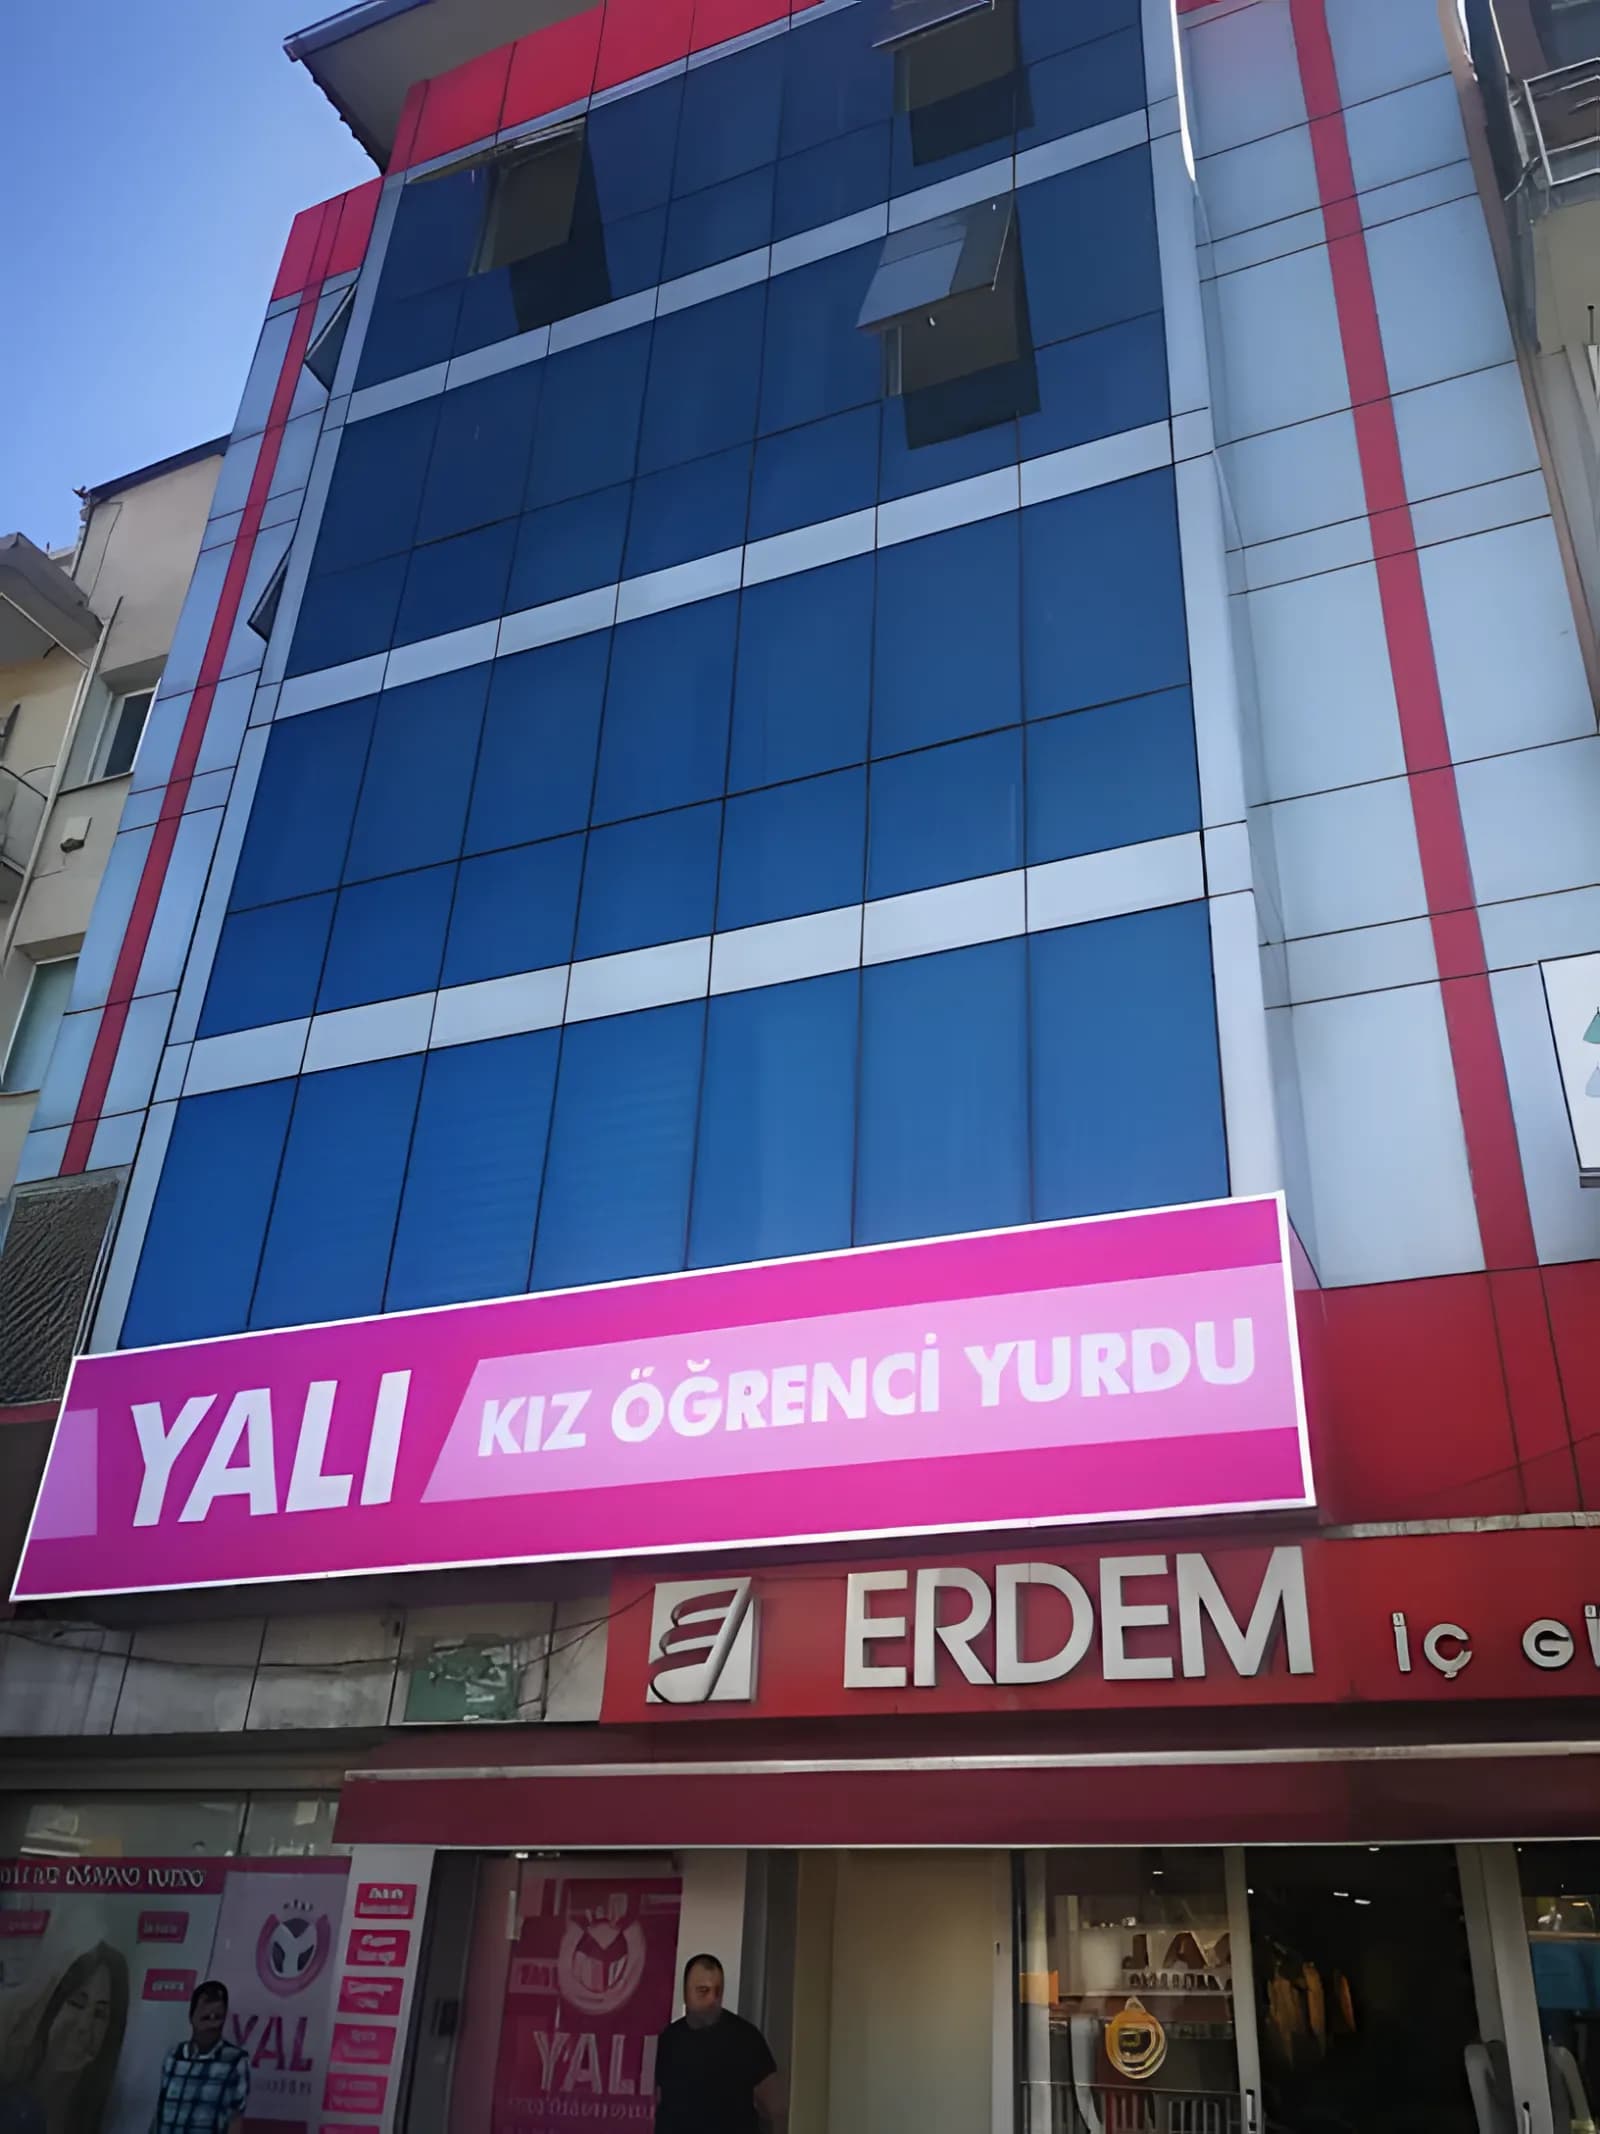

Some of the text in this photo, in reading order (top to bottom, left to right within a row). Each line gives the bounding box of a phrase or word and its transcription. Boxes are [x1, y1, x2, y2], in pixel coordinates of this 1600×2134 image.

[130, 1317, 1256, 1527] YALI KIZ ÖĞRENCİ YURDU
[843, 1545, 1315, 1689] ERDEM
[1391, 1611, 1473, 1679] İÇ
[533, 2031, 659, 2097] YALI
